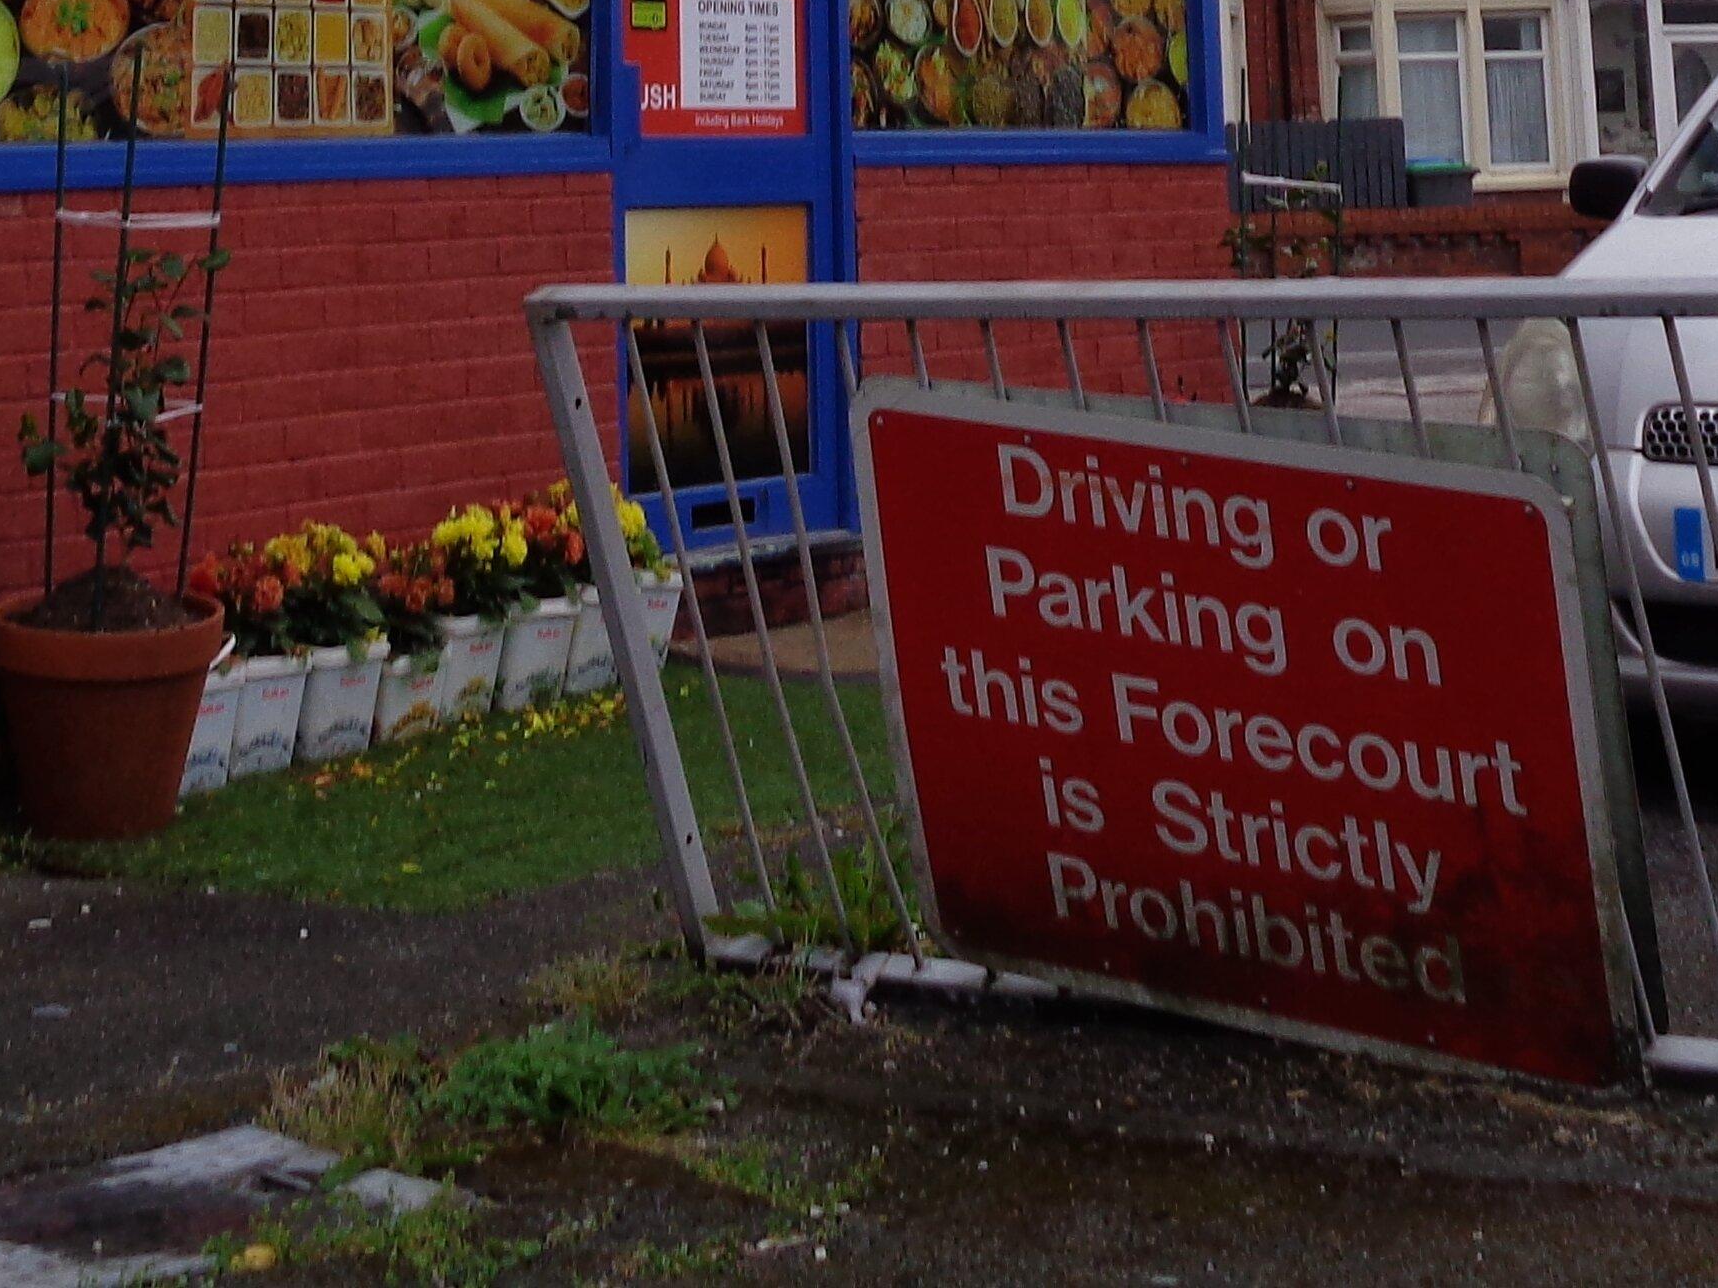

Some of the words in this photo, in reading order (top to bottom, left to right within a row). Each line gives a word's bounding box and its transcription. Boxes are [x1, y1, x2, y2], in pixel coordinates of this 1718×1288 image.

[698, 0, 745, 16] OPENING
[749, 1, 779, 17] TIMES
[695, 111, 729, 129] Including
[751, 113, 784, 130] Holidays
[996, 440, 1276, 570] Driving
[1305, 505, 1393, 573] or
[984, 543, 1289, 676] Parking
[1332, 615, 1444, 687] on
[941, 645, 1084, 735] this
[1111, 672, 1529, 818] Forecourt
[1038, 755, 1105, 832] is
[1152, 779, 1443, 915] Strictly
[1046, 850, 1468, 1005] Prohibited
